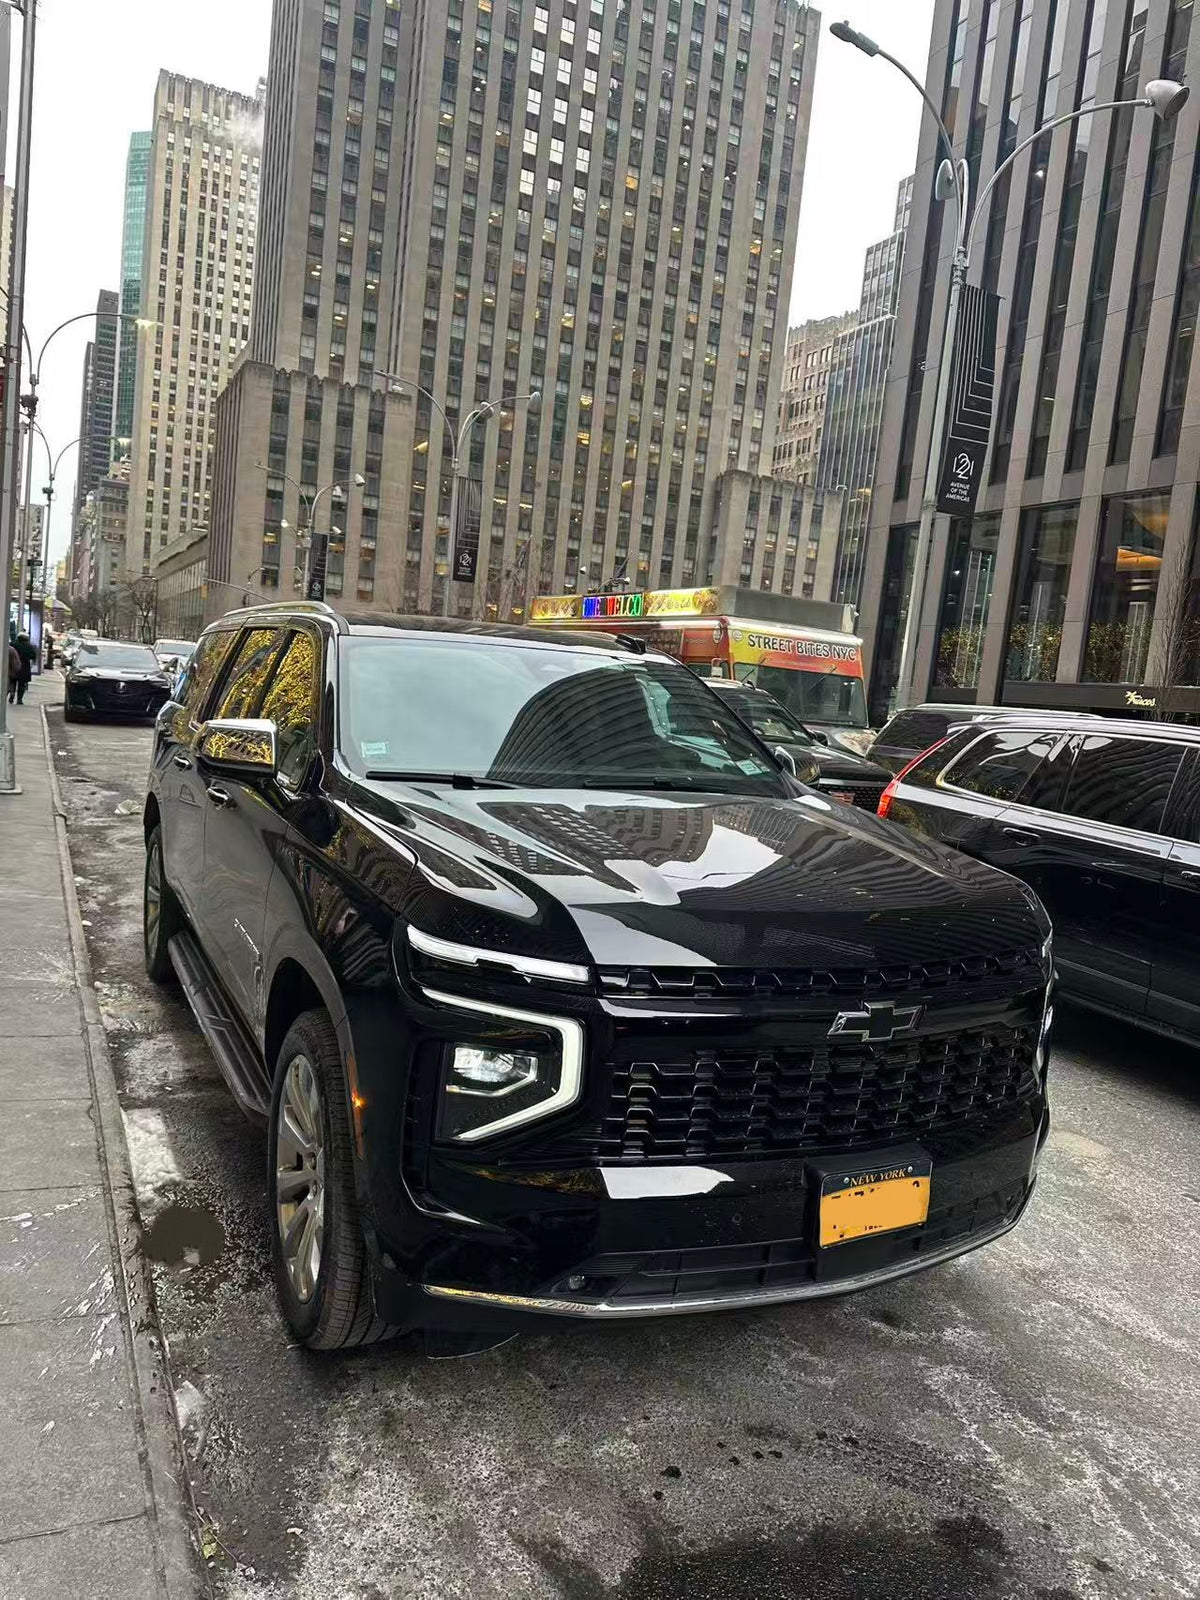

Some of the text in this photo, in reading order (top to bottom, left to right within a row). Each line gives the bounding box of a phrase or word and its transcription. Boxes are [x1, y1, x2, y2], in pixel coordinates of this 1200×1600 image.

[953, 452, 974, 479] 1221
[950, 481, 970, 490] AVENUE
[945, 493, 970, 502] AMERICAS
[748, 634, 792, 653] STREET
[796, 641, 831, 659] BITES
[832, 645, 856, 661] NYC
[849, 1168, 908, 1187] NEW YORK
